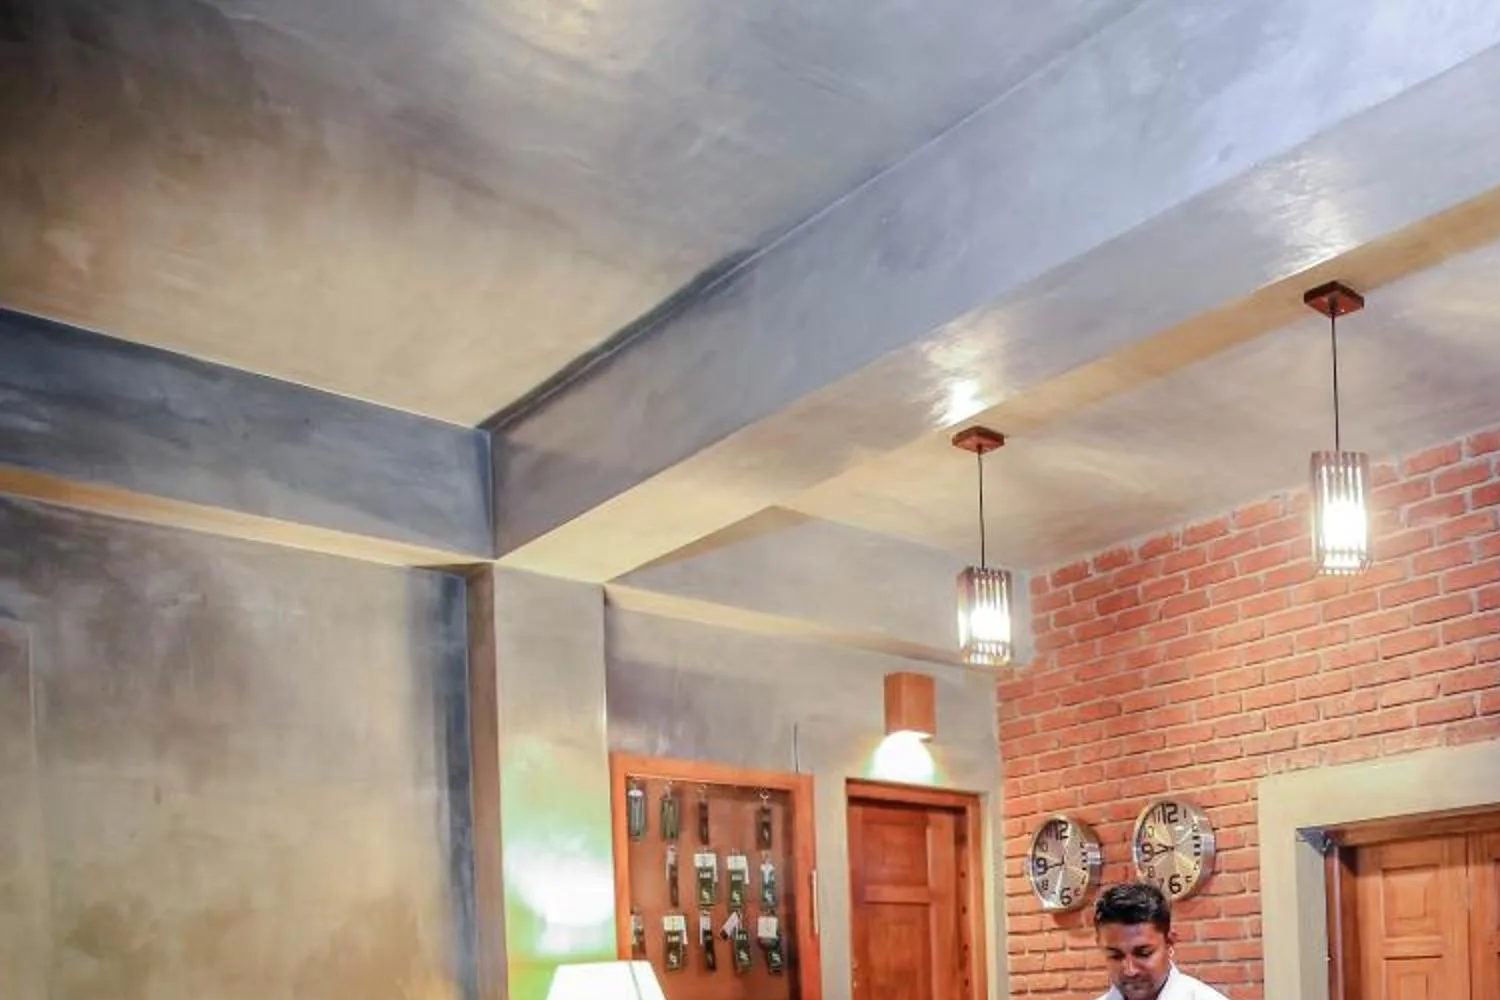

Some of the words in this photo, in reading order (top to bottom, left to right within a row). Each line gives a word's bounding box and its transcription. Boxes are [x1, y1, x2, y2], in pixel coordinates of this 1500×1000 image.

[1162, 803, 1178, 824] 12
[1036, 858, 1047, 875] 9
[1169, 874, 1182, 894] 6
[1061, 888, 1072, 905] 6
